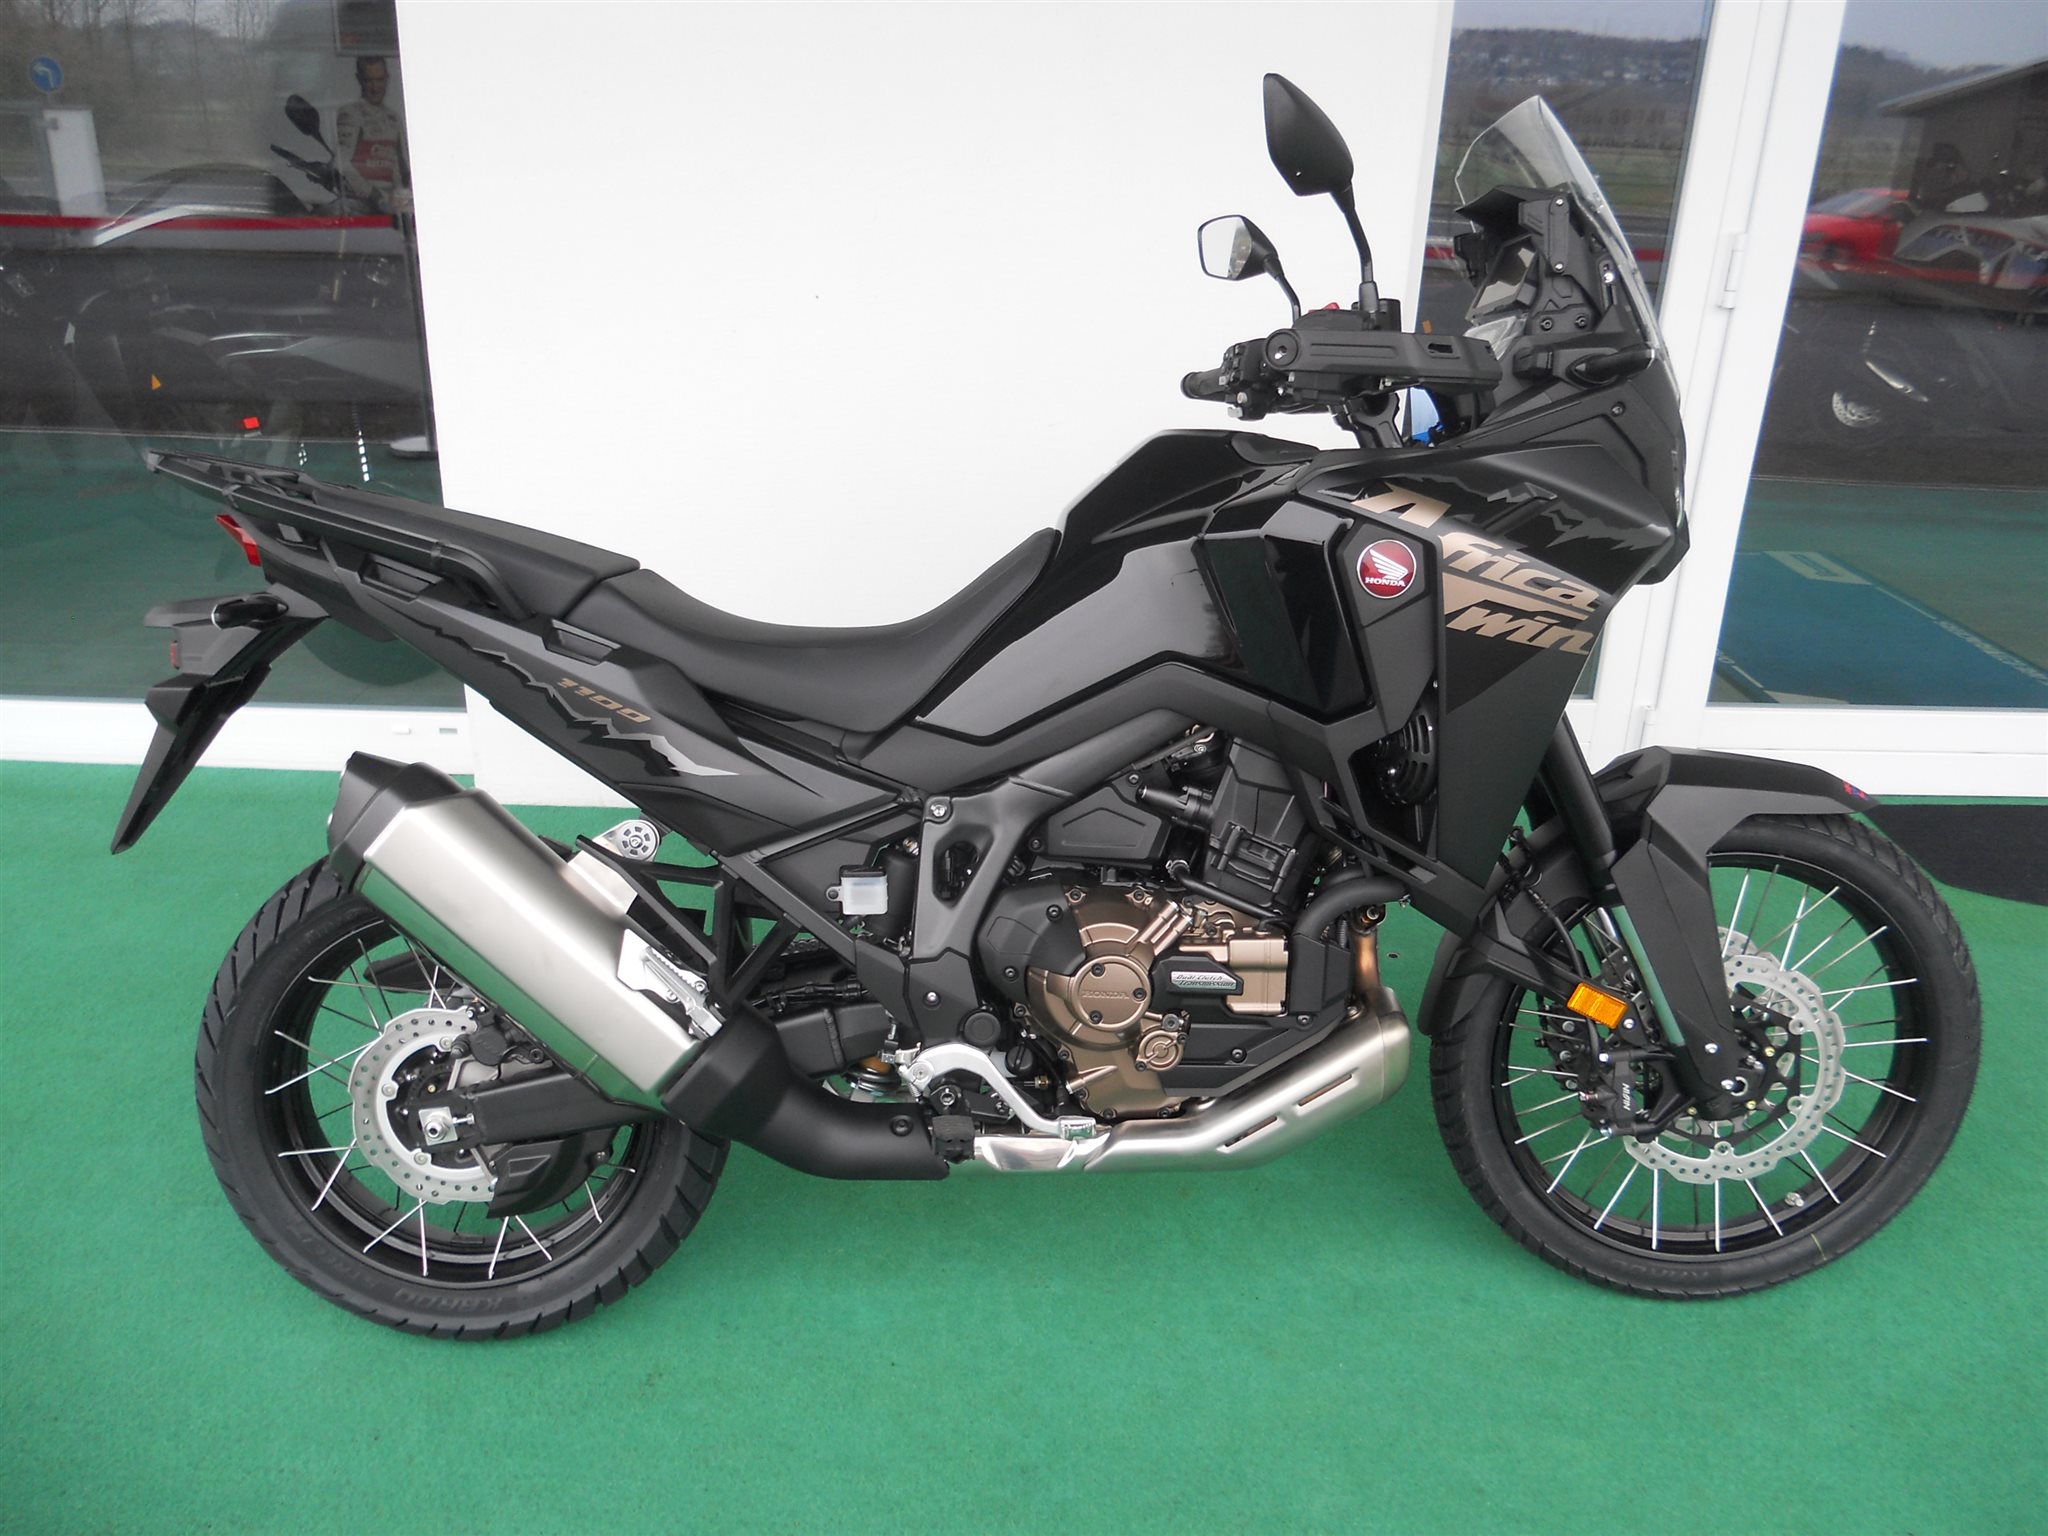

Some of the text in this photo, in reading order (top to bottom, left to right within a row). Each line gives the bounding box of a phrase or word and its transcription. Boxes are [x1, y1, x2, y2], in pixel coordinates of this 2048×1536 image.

[1365, 577, 1406, 587] HONDA
[557, 678, 651, 723] 1100
[1081, 991, 1130, 1000] HONDA
